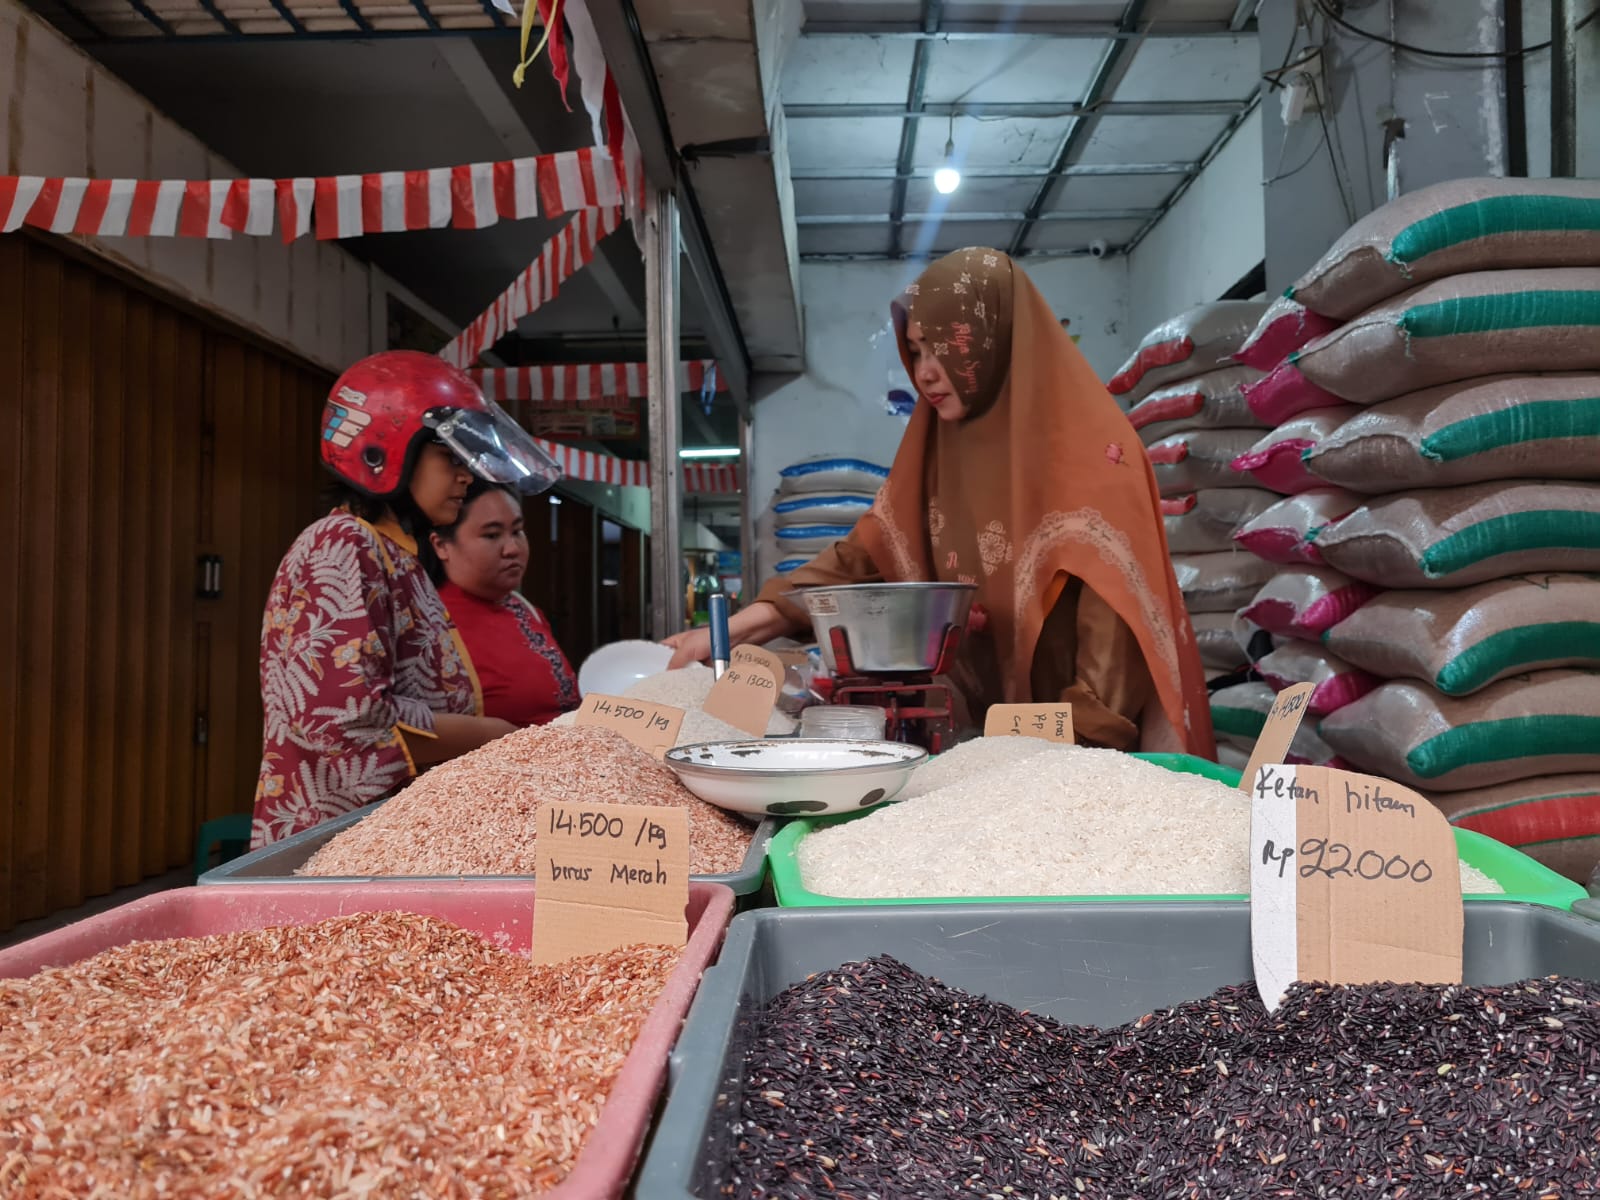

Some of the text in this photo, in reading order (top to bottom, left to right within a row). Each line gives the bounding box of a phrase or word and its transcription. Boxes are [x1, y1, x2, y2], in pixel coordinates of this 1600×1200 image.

[592, 700, 645, 719] 14.500
[1345, 781, 1415, 818] hitam
[550, 808, 624, 838] 14.500
[610, 859, 667, 885] Merah
[1263, 839, 1295, 878] Rp
